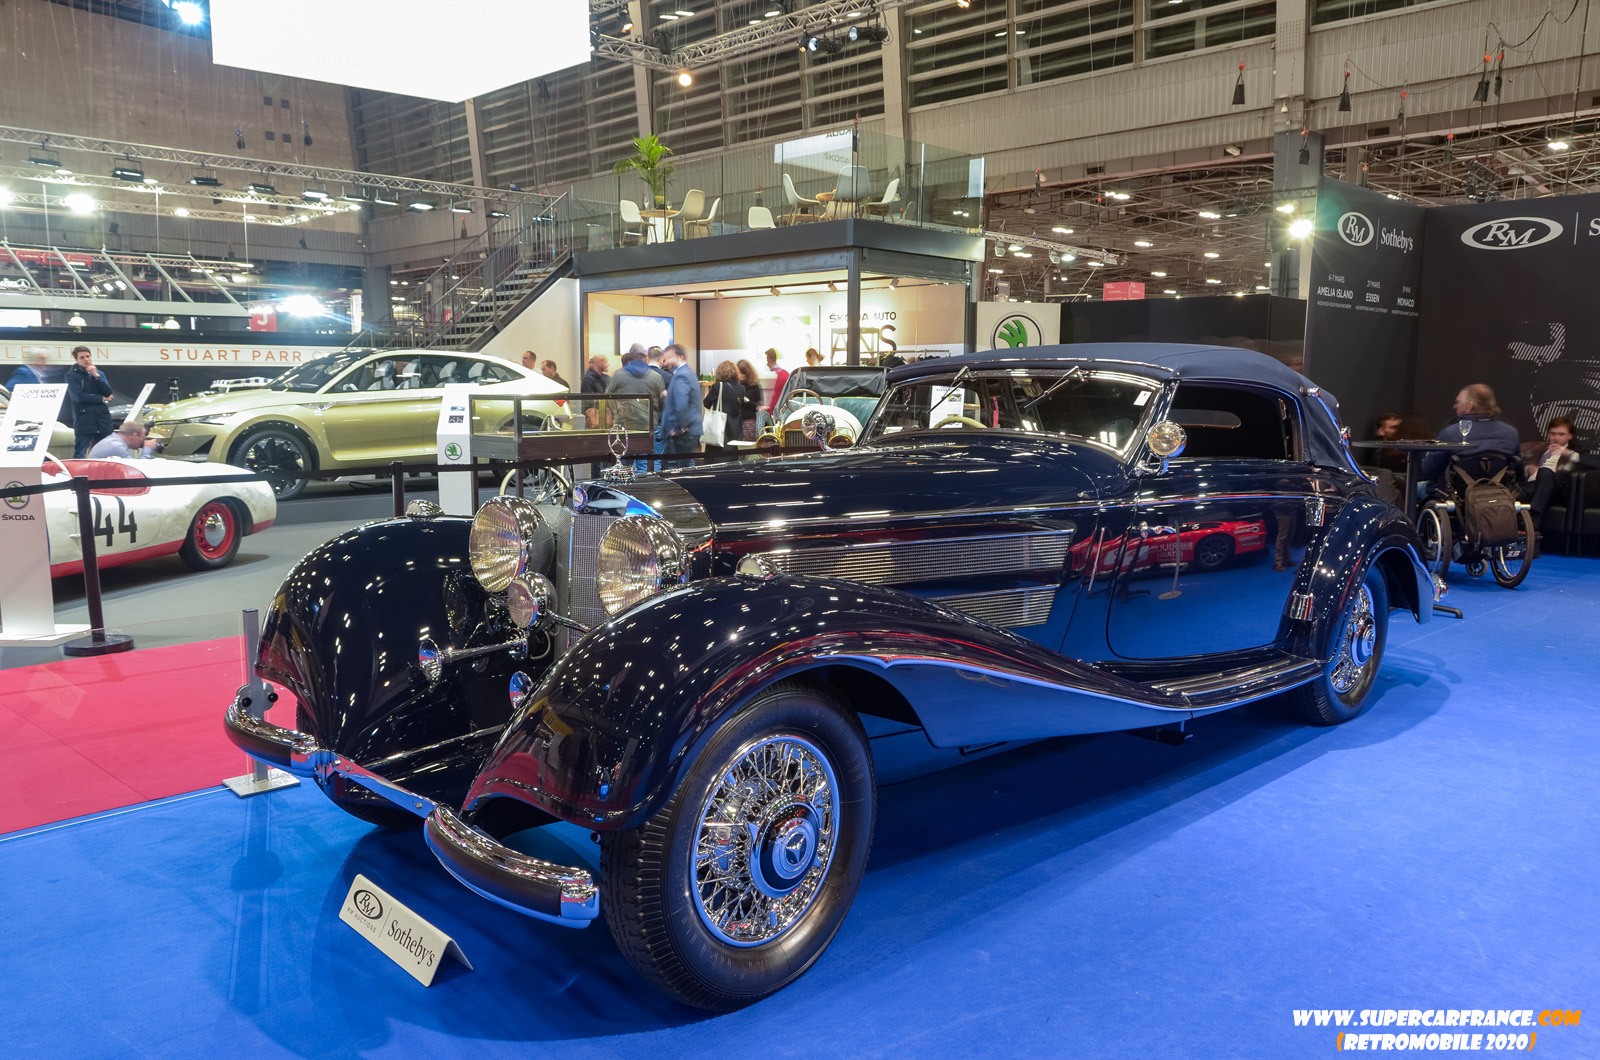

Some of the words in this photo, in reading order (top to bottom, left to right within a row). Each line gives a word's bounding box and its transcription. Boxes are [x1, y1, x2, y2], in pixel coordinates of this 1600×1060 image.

[1346, 216, 1365, 242] RM
[1381, 228, 1413, 254] Sotheby's
[1481, 222, 1537, 246] RM
[1335, 275, 1345, 284] MARS
[1317, 286, 1336, 297] AMELIA
[1336, 289, 1353, 300] ISLAND
[1366, 293, 1380, 302] ESSEN
[1397, 297, 1414, 308] MONACO
[829, 312, 869, 323] ŠKA
[873, 311, 897, 321] AUTO
[159, 348, 241, 361] STUART
[252, 350, 302, 362] PARR
[1, 513, 36, 521] ŠKODA
[92, 495, 138, 547] 44
[354, 913, 376, 933] AUCTIONS
[359, 894, 376, 916] RM
[388, 920, 435, 967] Sotheby's
